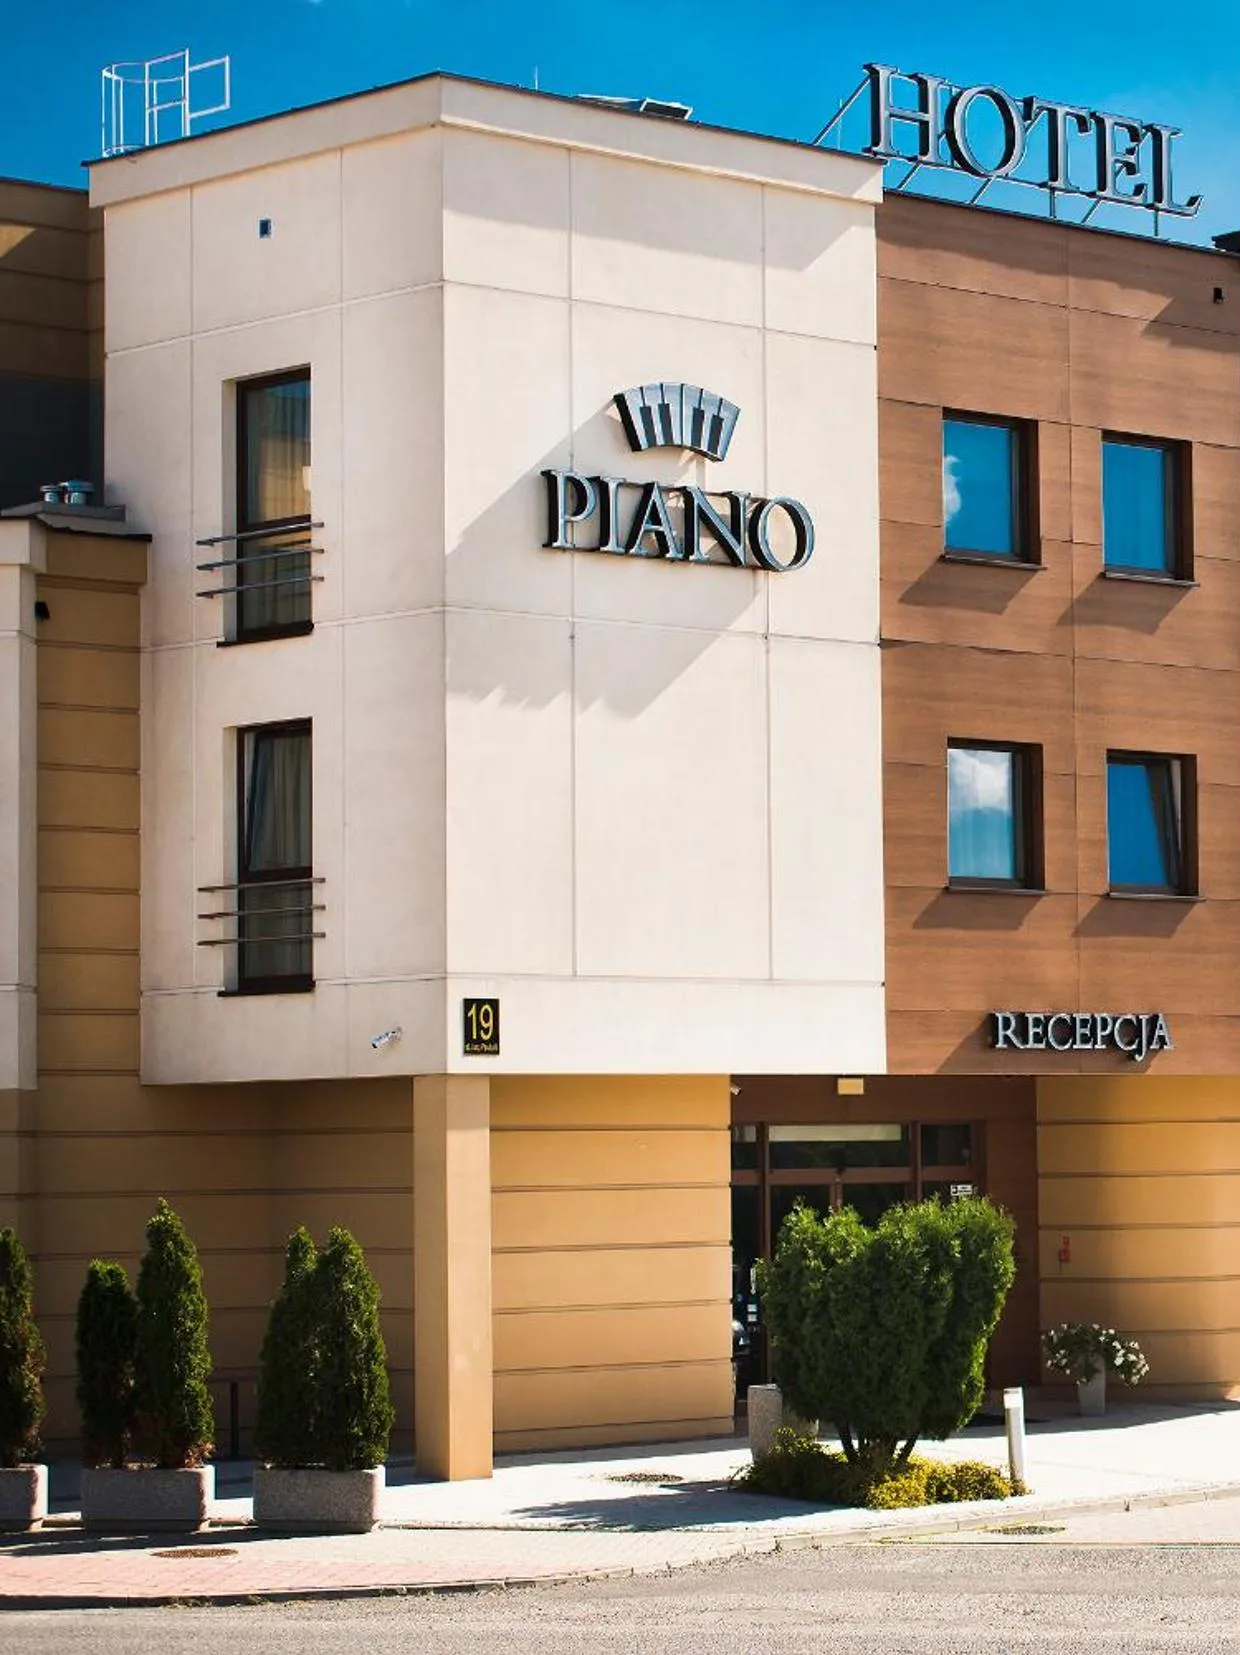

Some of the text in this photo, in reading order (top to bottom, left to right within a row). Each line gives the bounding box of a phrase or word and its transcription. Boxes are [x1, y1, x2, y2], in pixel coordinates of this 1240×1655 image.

[863, 62, 1203, 217] HOTEL
[541, 469, 815, 572] PIANO
[467, 1003, 494, 1041] 19
[992, 1012, 1174, 1062] RECEPCJA
